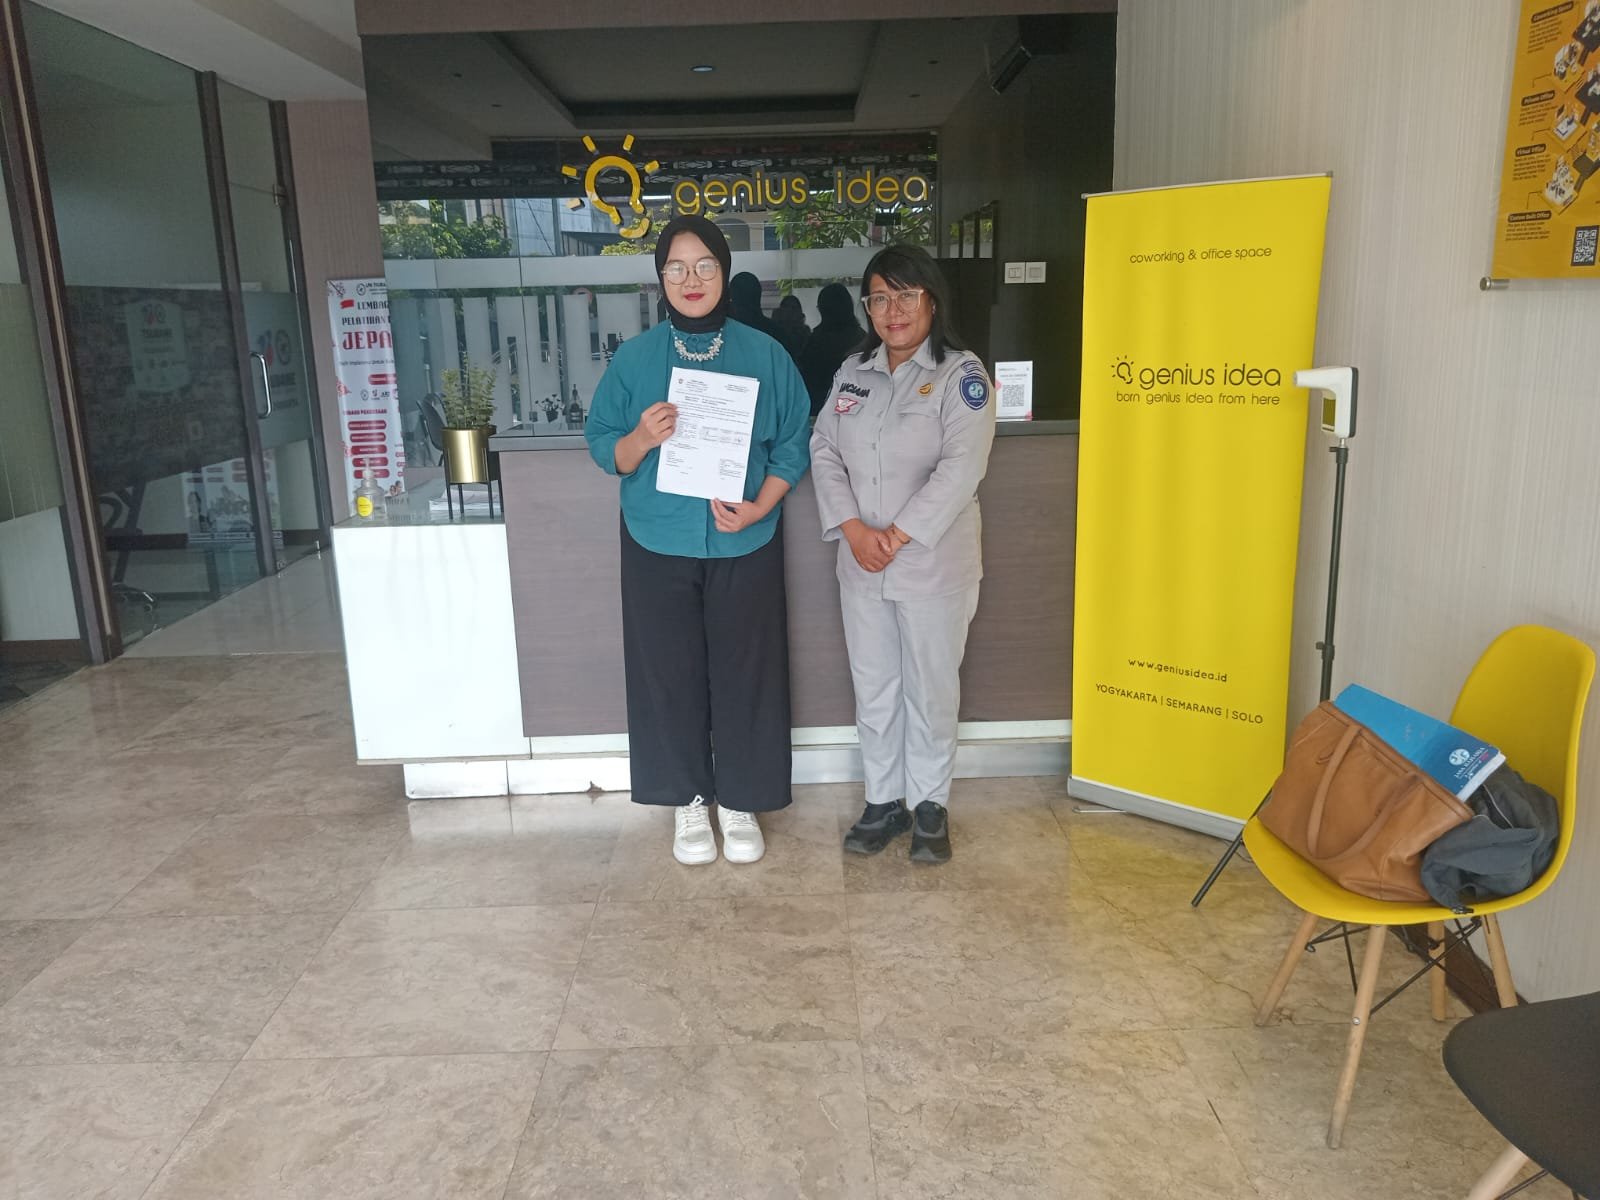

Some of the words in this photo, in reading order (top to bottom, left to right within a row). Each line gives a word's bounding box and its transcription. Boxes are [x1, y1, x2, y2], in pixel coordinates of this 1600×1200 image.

[674, 171, 806, 215] genius
[837, 169, 928, 205] idea
[1130, 251, 1185, 264] coworking
[1187, 249, 1197, 261] &
[1200, 247, 1232, 260] office
[1235, 247, 1272, 260] space
[1139, 363, 1215, 390] genius
[1223, 363, 1281, 386] idea
[1116, 391, 1140, 402] born
[1145, 393, 1181, 405] genius
[1186, 393, 1213, 404] idea
[1218, 393, 1246, 405] from
[1251, 393, 1280, 405] here
[1127, 658, 1228, 683] www.geniusidea.id
[1095, 683, 1158, 704] YOGYAKARTA
[1166, 697, 1223, 716] SEMARANG
[1231, 710, 1264, 724] SOLO
